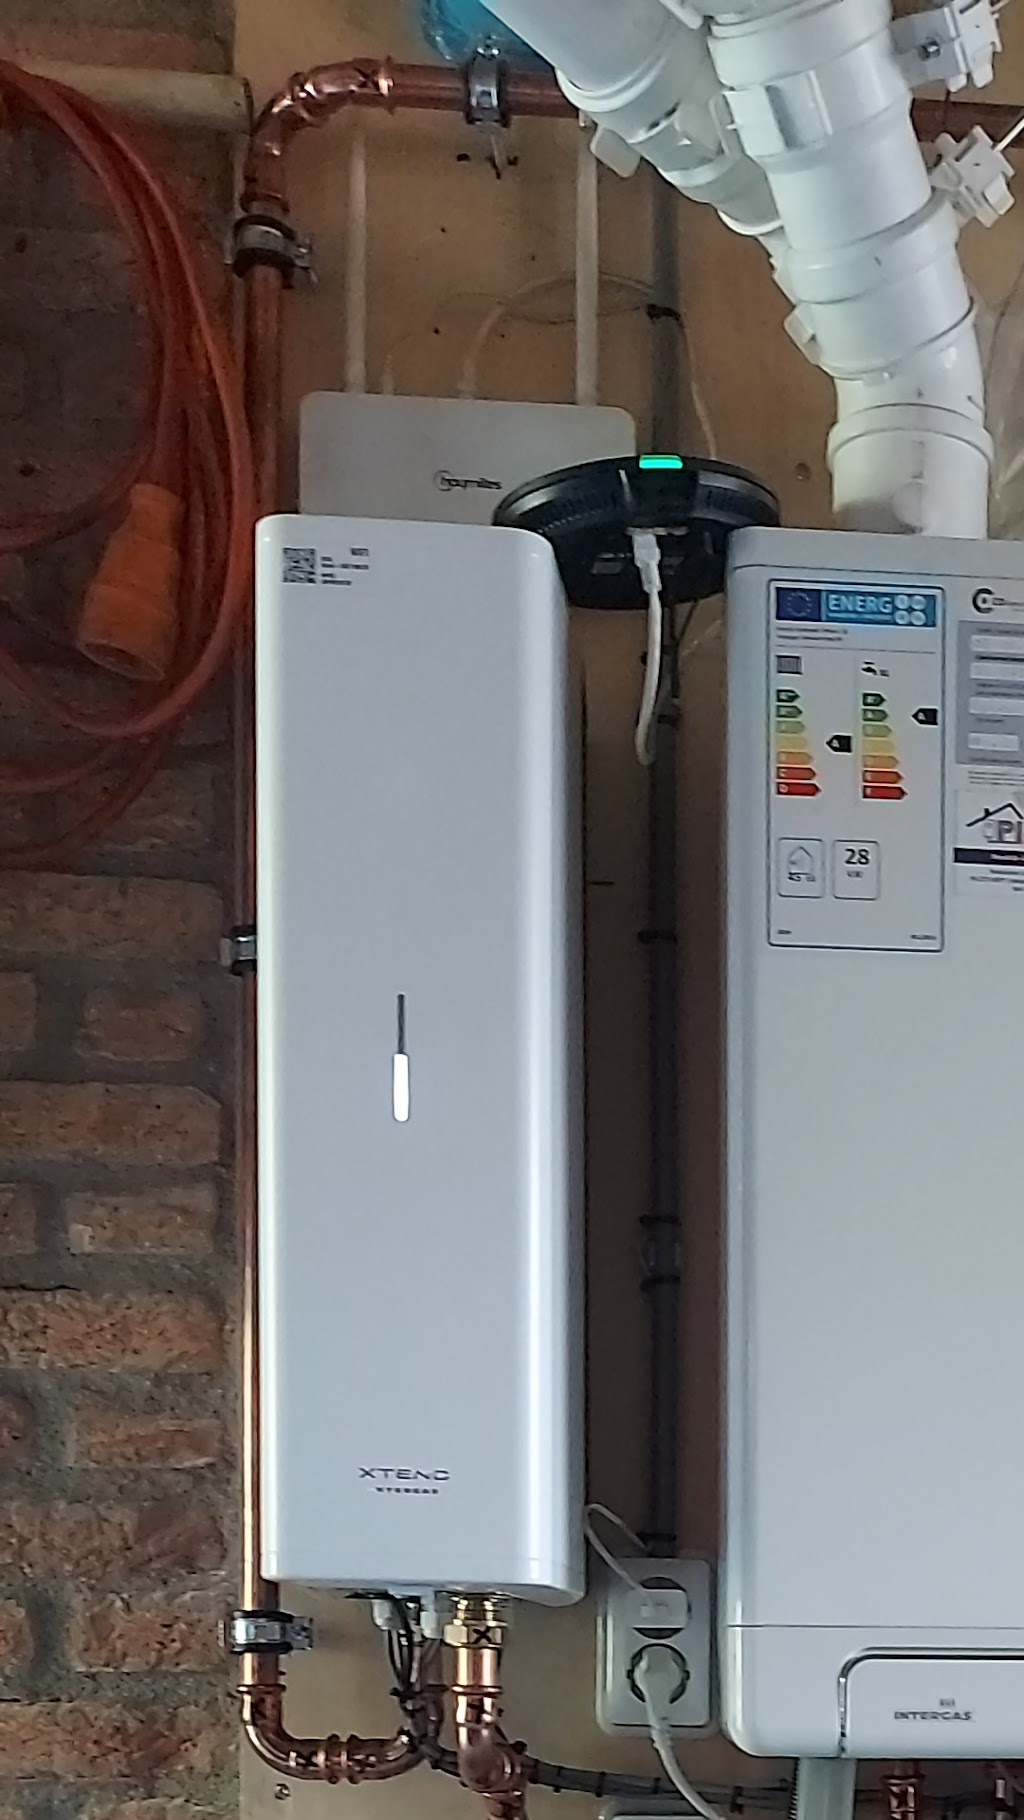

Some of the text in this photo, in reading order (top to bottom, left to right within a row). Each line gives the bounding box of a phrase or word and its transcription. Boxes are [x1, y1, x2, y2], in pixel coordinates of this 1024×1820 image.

[828, 594, 893, 615] ENERG
[845, 848, 870, 865] 28
[894, 1711, 972, 1721] INTERGAS
